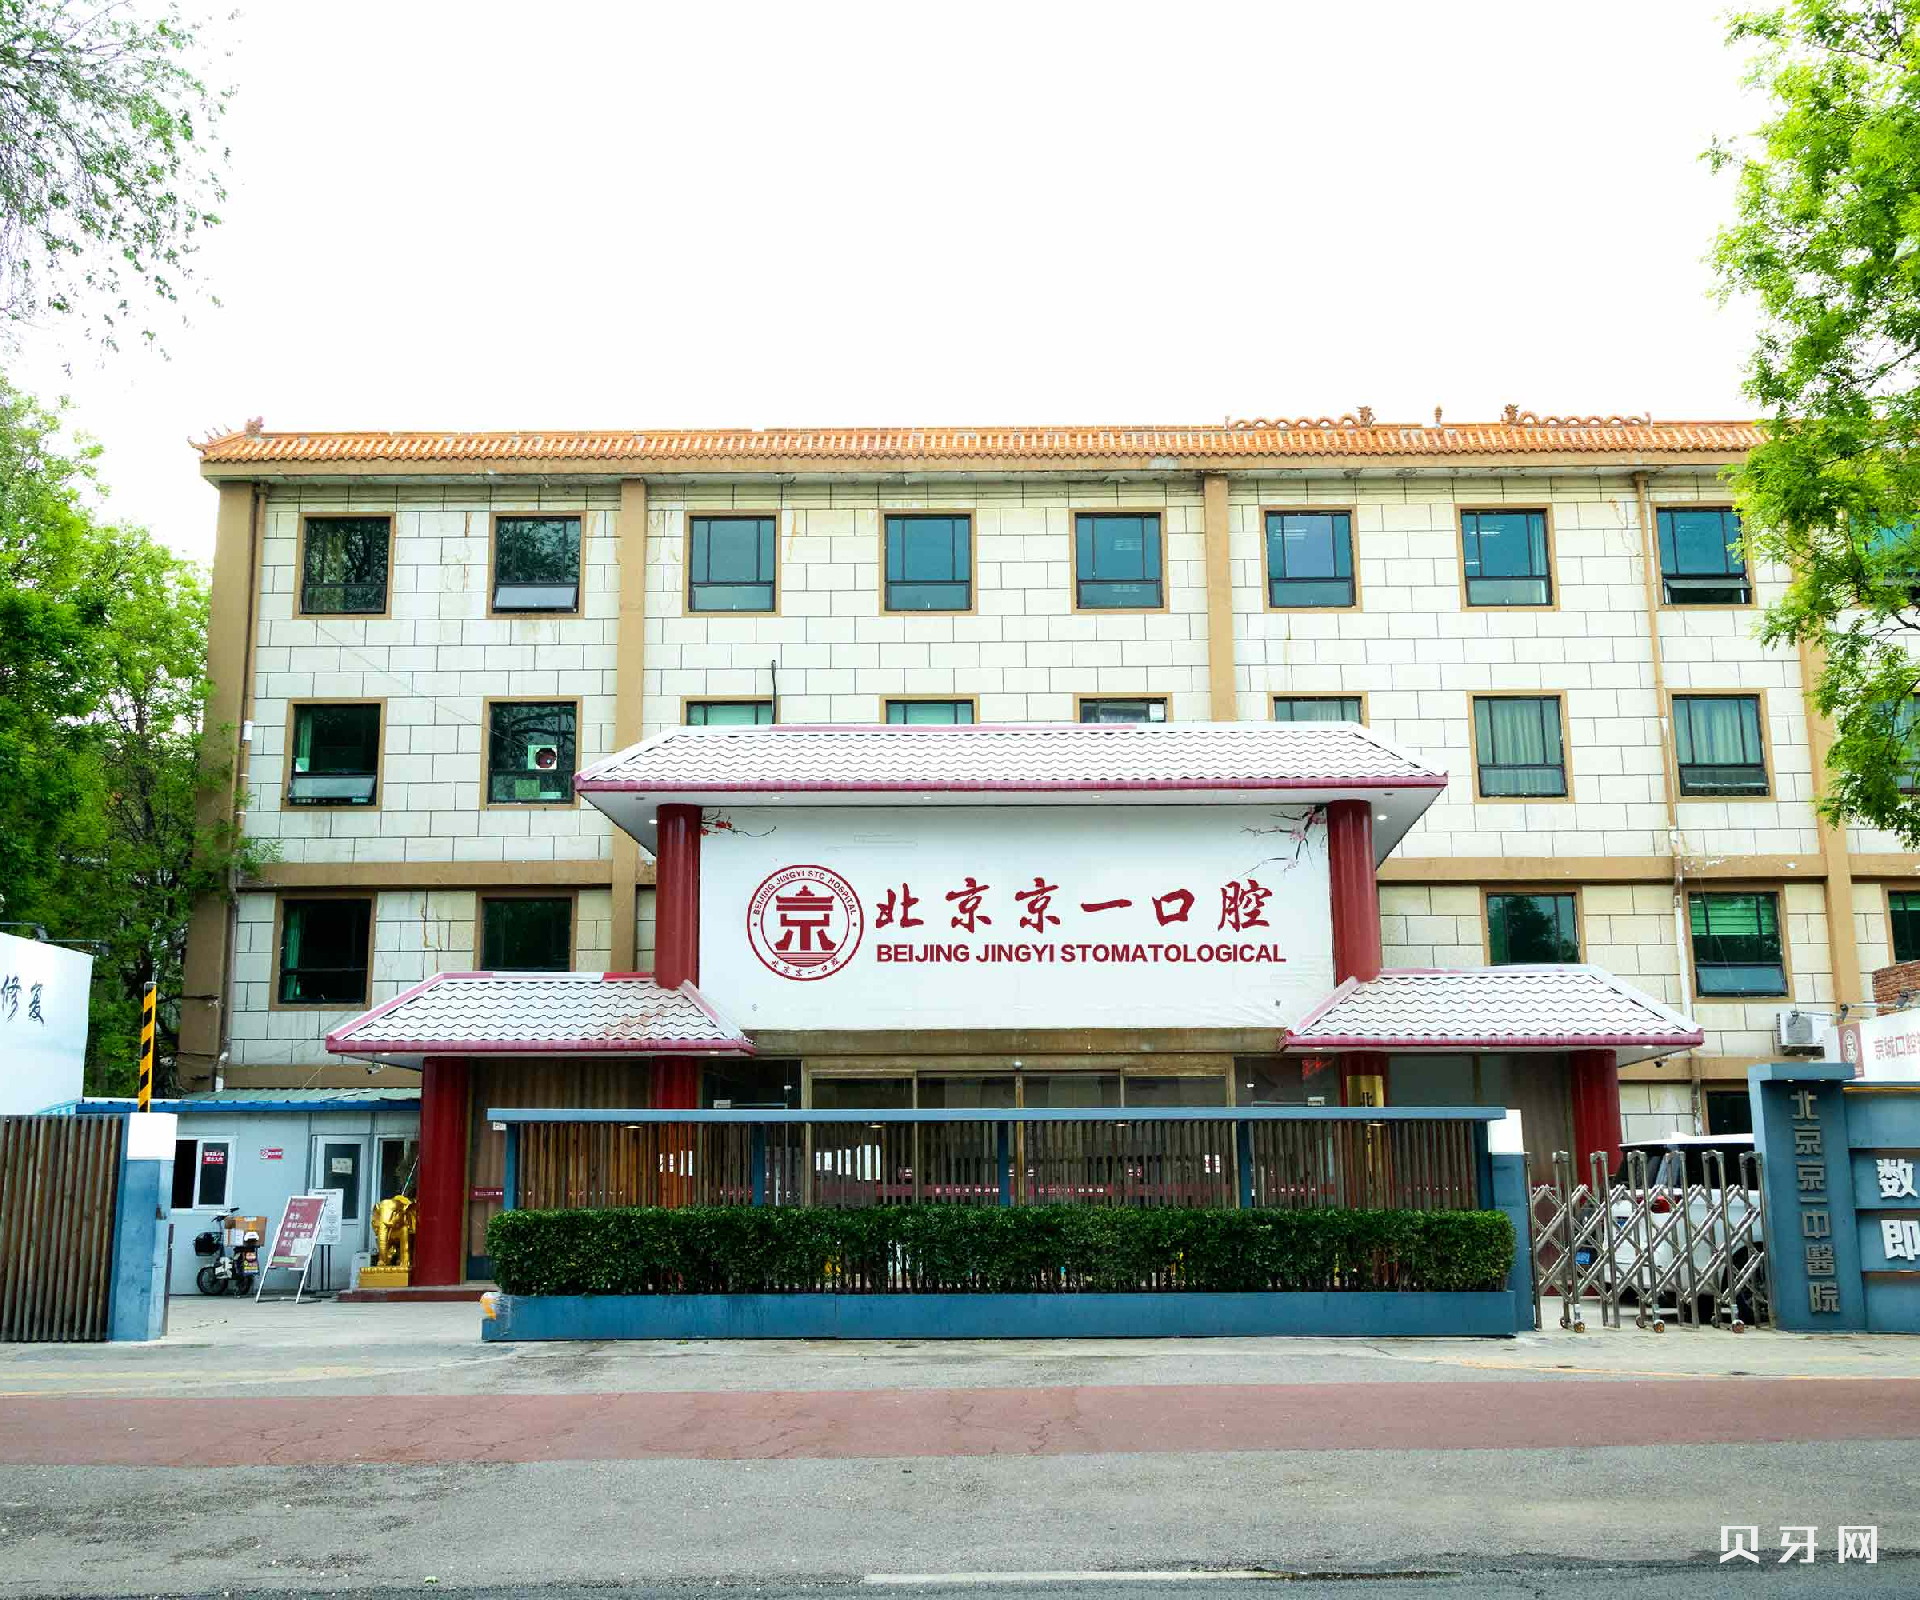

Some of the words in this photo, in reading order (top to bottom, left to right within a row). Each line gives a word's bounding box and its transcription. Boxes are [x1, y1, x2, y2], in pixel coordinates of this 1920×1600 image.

[753, 883, 776, 915] BEIJING
[776, 870, 805, 885] JINGYI
[827, 877, 857, 915] HOSPITAL
[876, 877, 1273, 933] 北京京一口腔
[877, 944, 970, 963] BEIJING
[975, 944, 1054, 963] JINGYI
[1060, 944, 1286, 963] STOMATOLOGICAL
[1876, 1158, 1918, 1199] 数
[1880, 1219, 1920, 1261] 即
